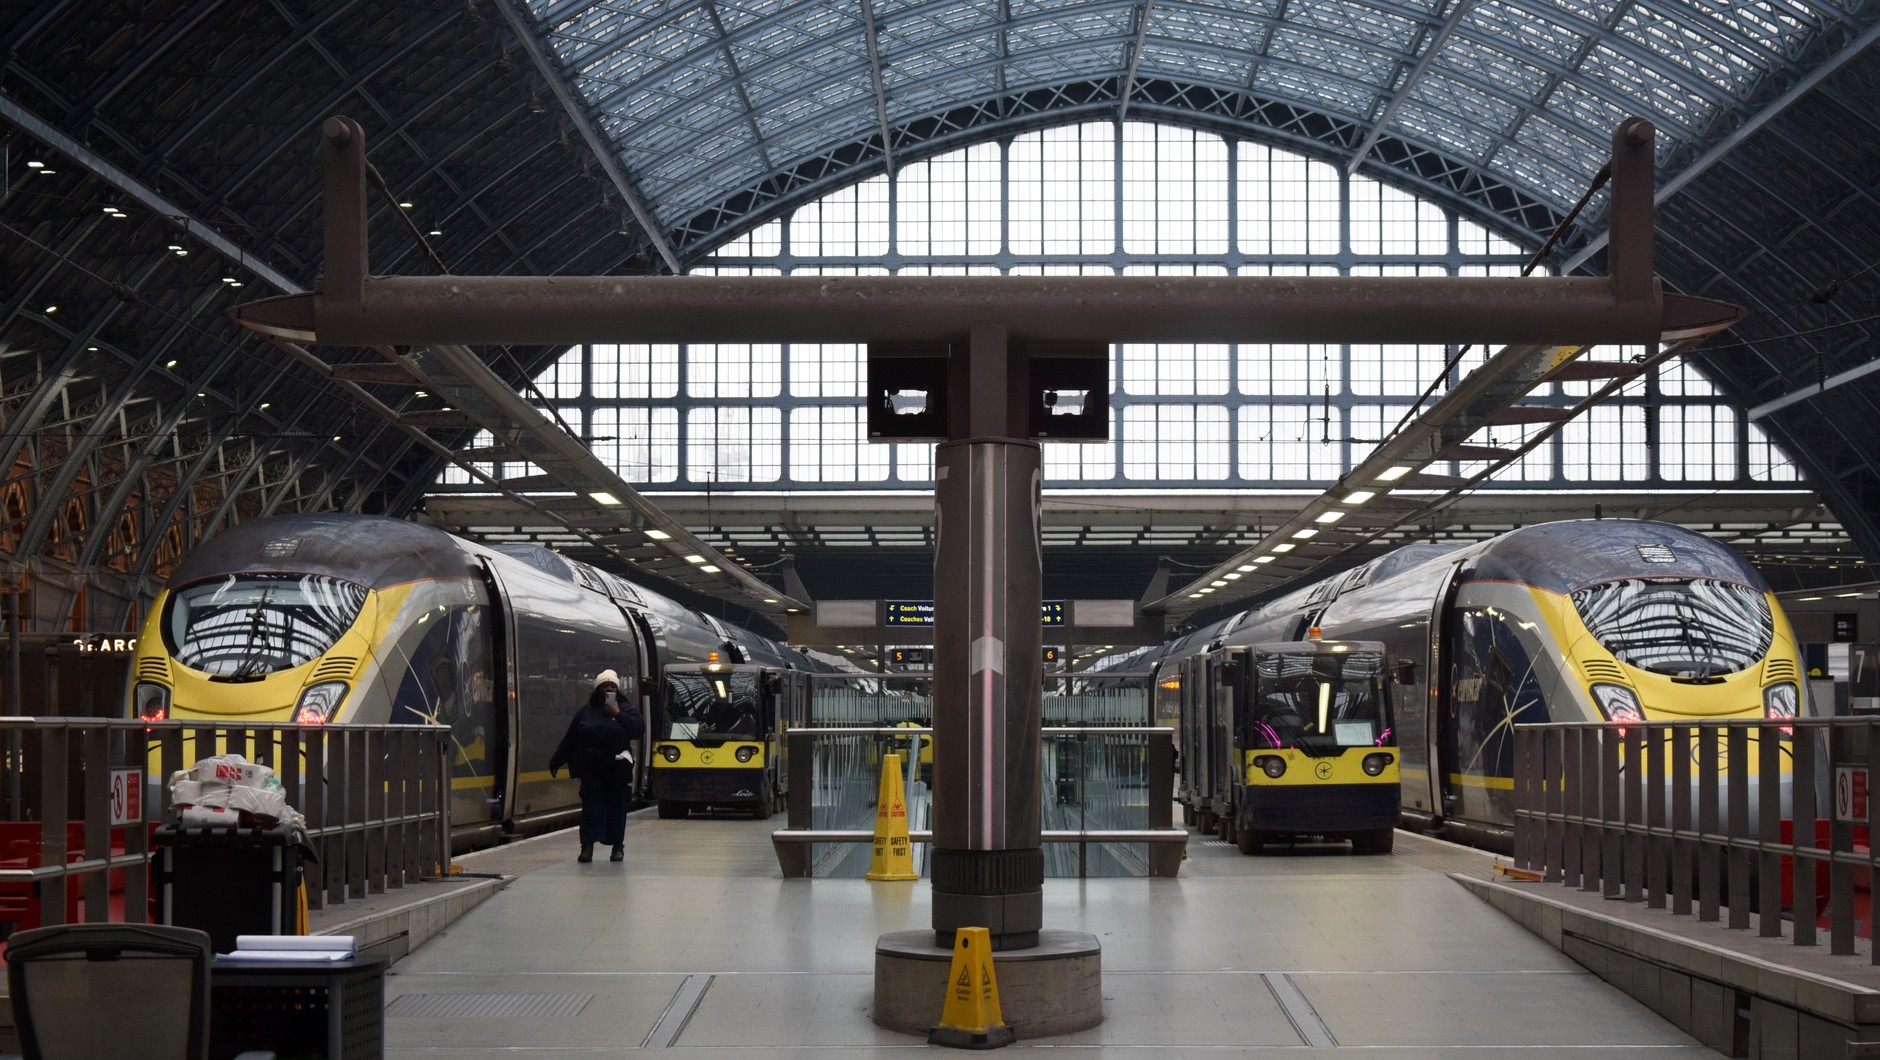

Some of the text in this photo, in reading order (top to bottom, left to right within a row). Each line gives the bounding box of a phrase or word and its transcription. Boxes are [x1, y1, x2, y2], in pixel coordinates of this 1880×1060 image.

[896, 652, 903, 661] 5
[1046, 651, 1053, 660] 6
[1855, 650, 1865, 684] 7
[891, 837, 907, 846] SAFETY
[893, 848, 905, 856] FIRST
